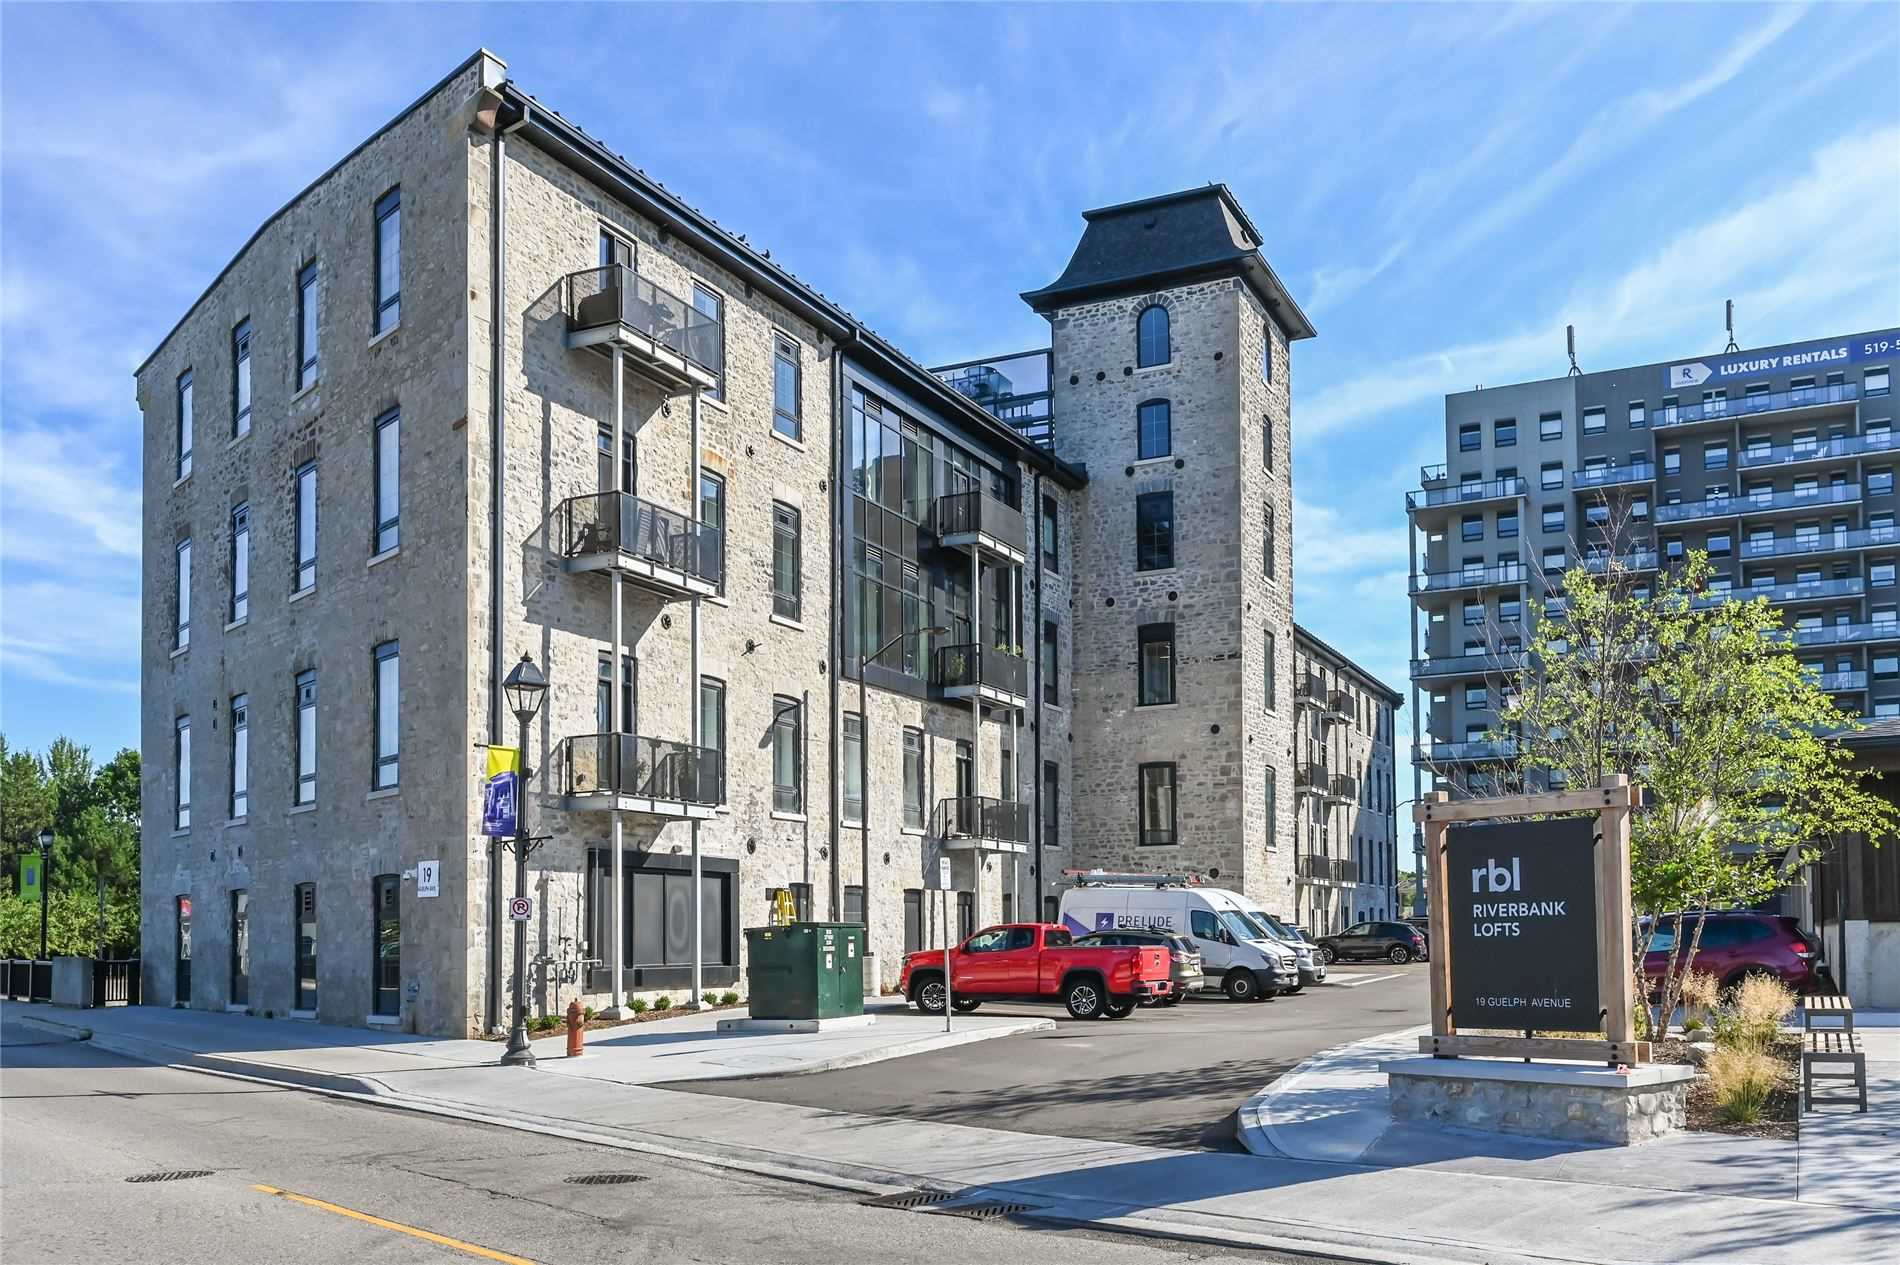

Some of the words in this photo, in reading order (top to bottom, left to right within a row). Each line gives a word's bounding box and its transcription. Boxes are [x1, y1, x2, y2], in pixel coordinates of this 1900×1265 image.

[1720, 357, 1780, 376] LUXURY
[1782, 347, 1848, 367] RENTALS
[1682, 368, 1693, 379] R
[423, 867, 432, 883] 19
[1472, 857, 1520, 893] rbl
[1473, 901, 1567, 918] RIVERBANK
[1118, 914, 1173, 928] PRELUDE
[1474, 922, 1521, 937] LOFTS
[1475, 997, 1485, 1007] 19
[1487, 997, 1527, 1007] GUELPH
[1531, 998, 1572, 1008] AVENUE
